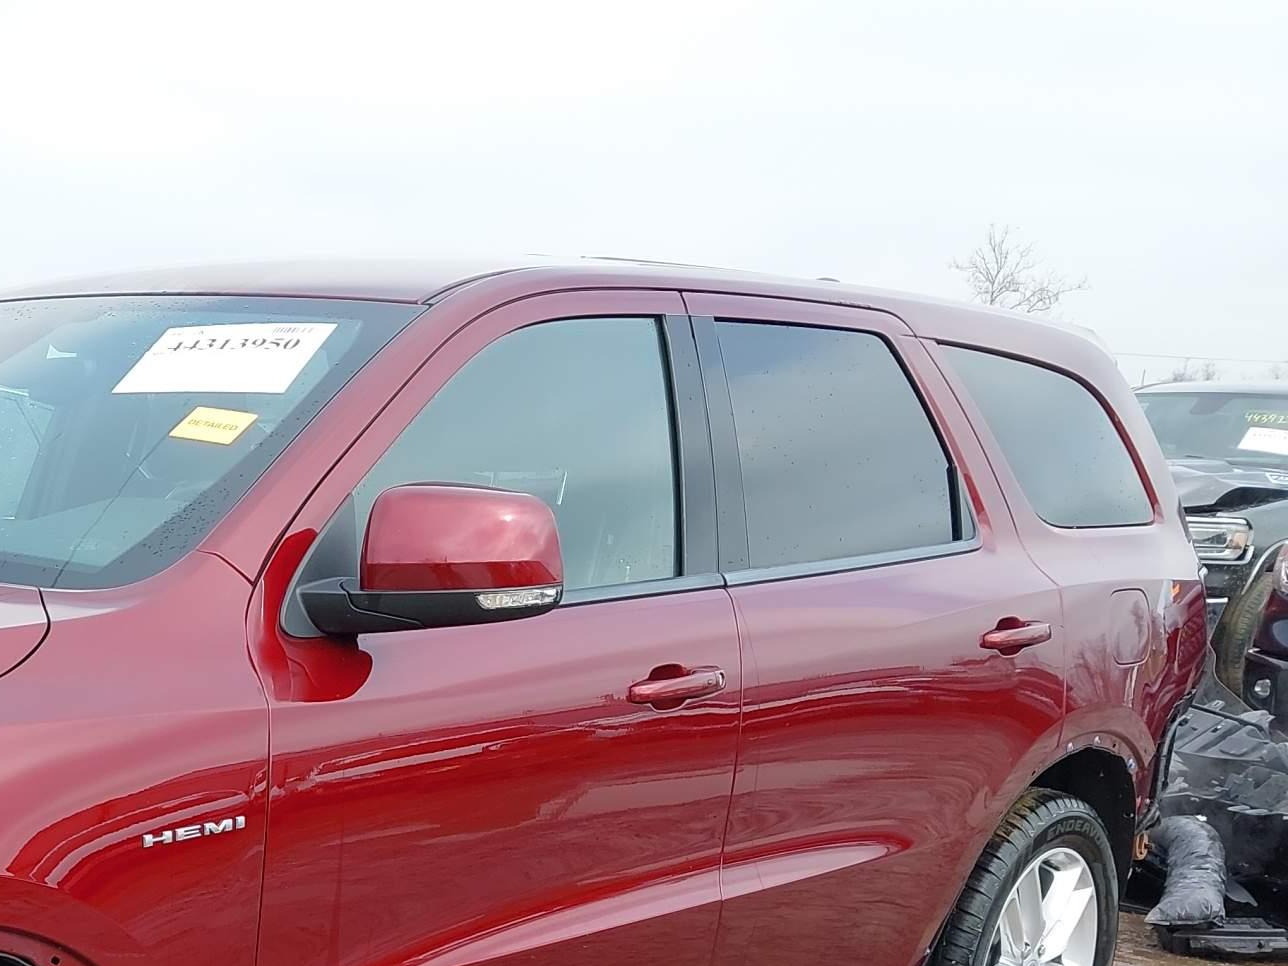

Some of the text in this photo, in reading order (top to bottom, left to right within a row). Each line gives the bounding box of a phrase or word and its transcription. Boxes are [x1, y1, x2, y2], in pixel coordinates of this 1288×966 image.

[167, 338, 301, 351] 44313950
[187, 419, 239, 431] DETAILED
[142, 815, 245, 848] HEMI
